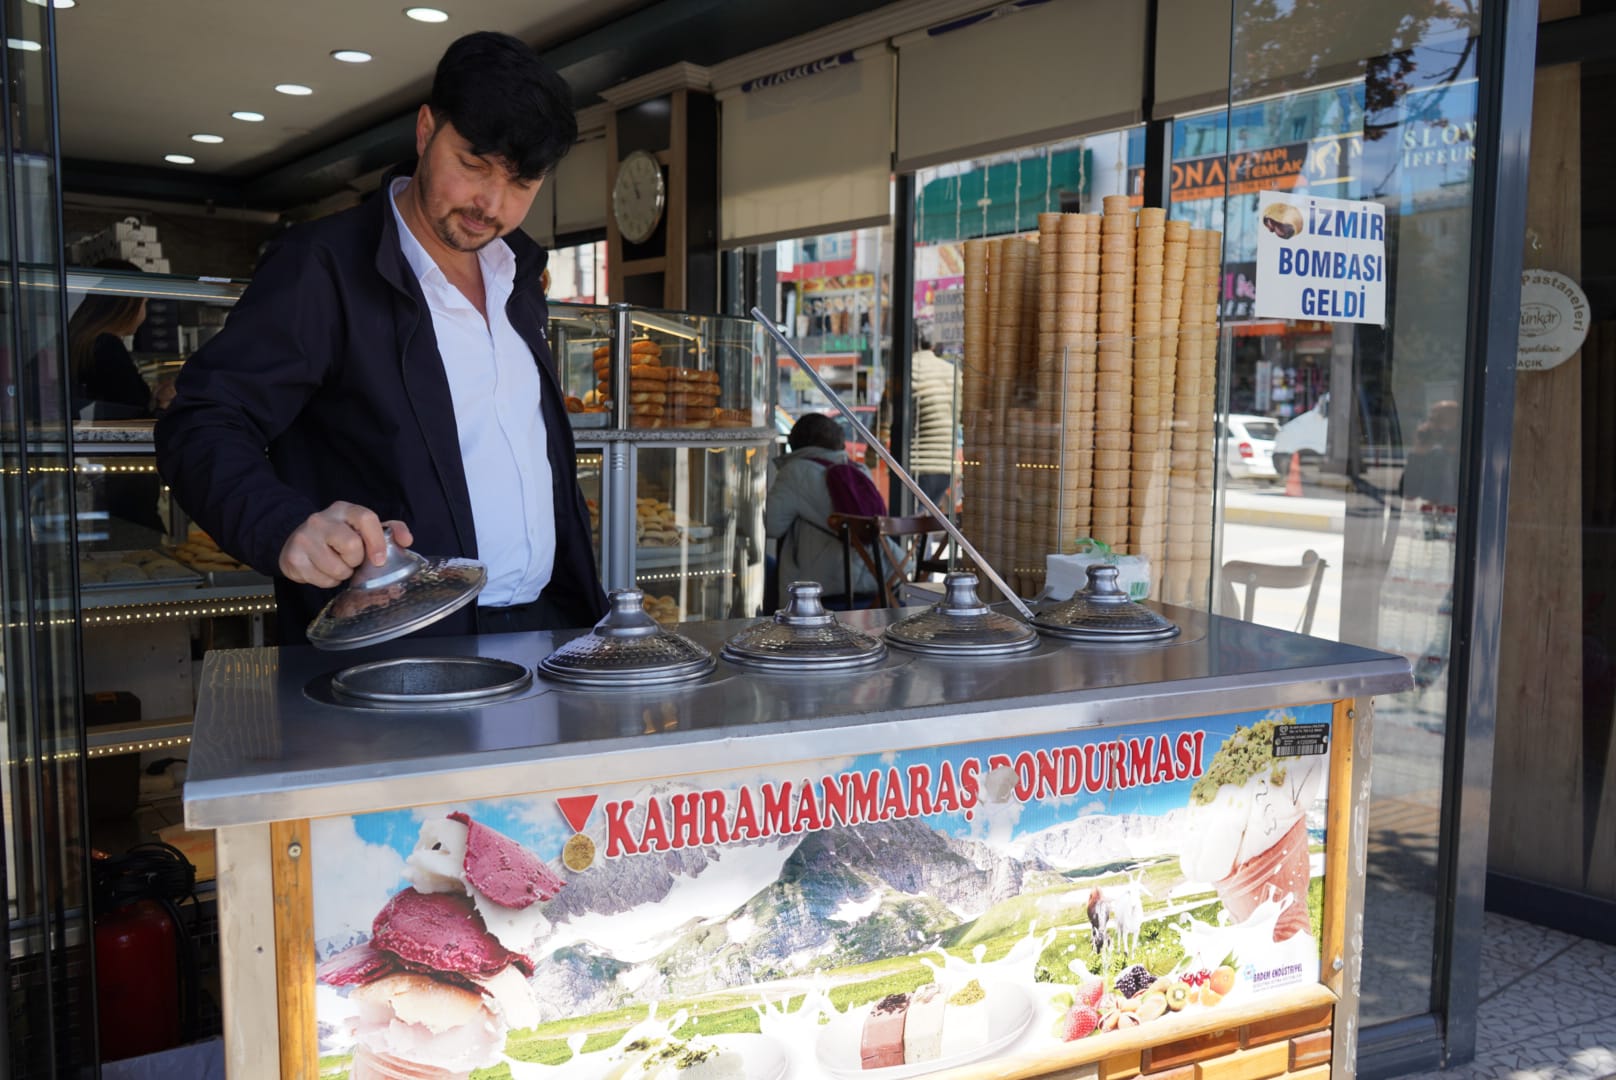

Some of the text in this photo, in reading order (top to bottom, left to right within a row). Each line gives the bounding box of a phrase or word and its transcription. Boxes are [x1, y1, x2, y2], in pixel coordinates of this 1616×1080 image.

[1308, 200, 1384, 241] İZMİR
[1279, 247, 1382, 282] BOMBASI
[1301, 285, 1366, 318] GELDİ
[605, 731, 1205, 858] KAHRAMANMARAŞ ONDURMASI
